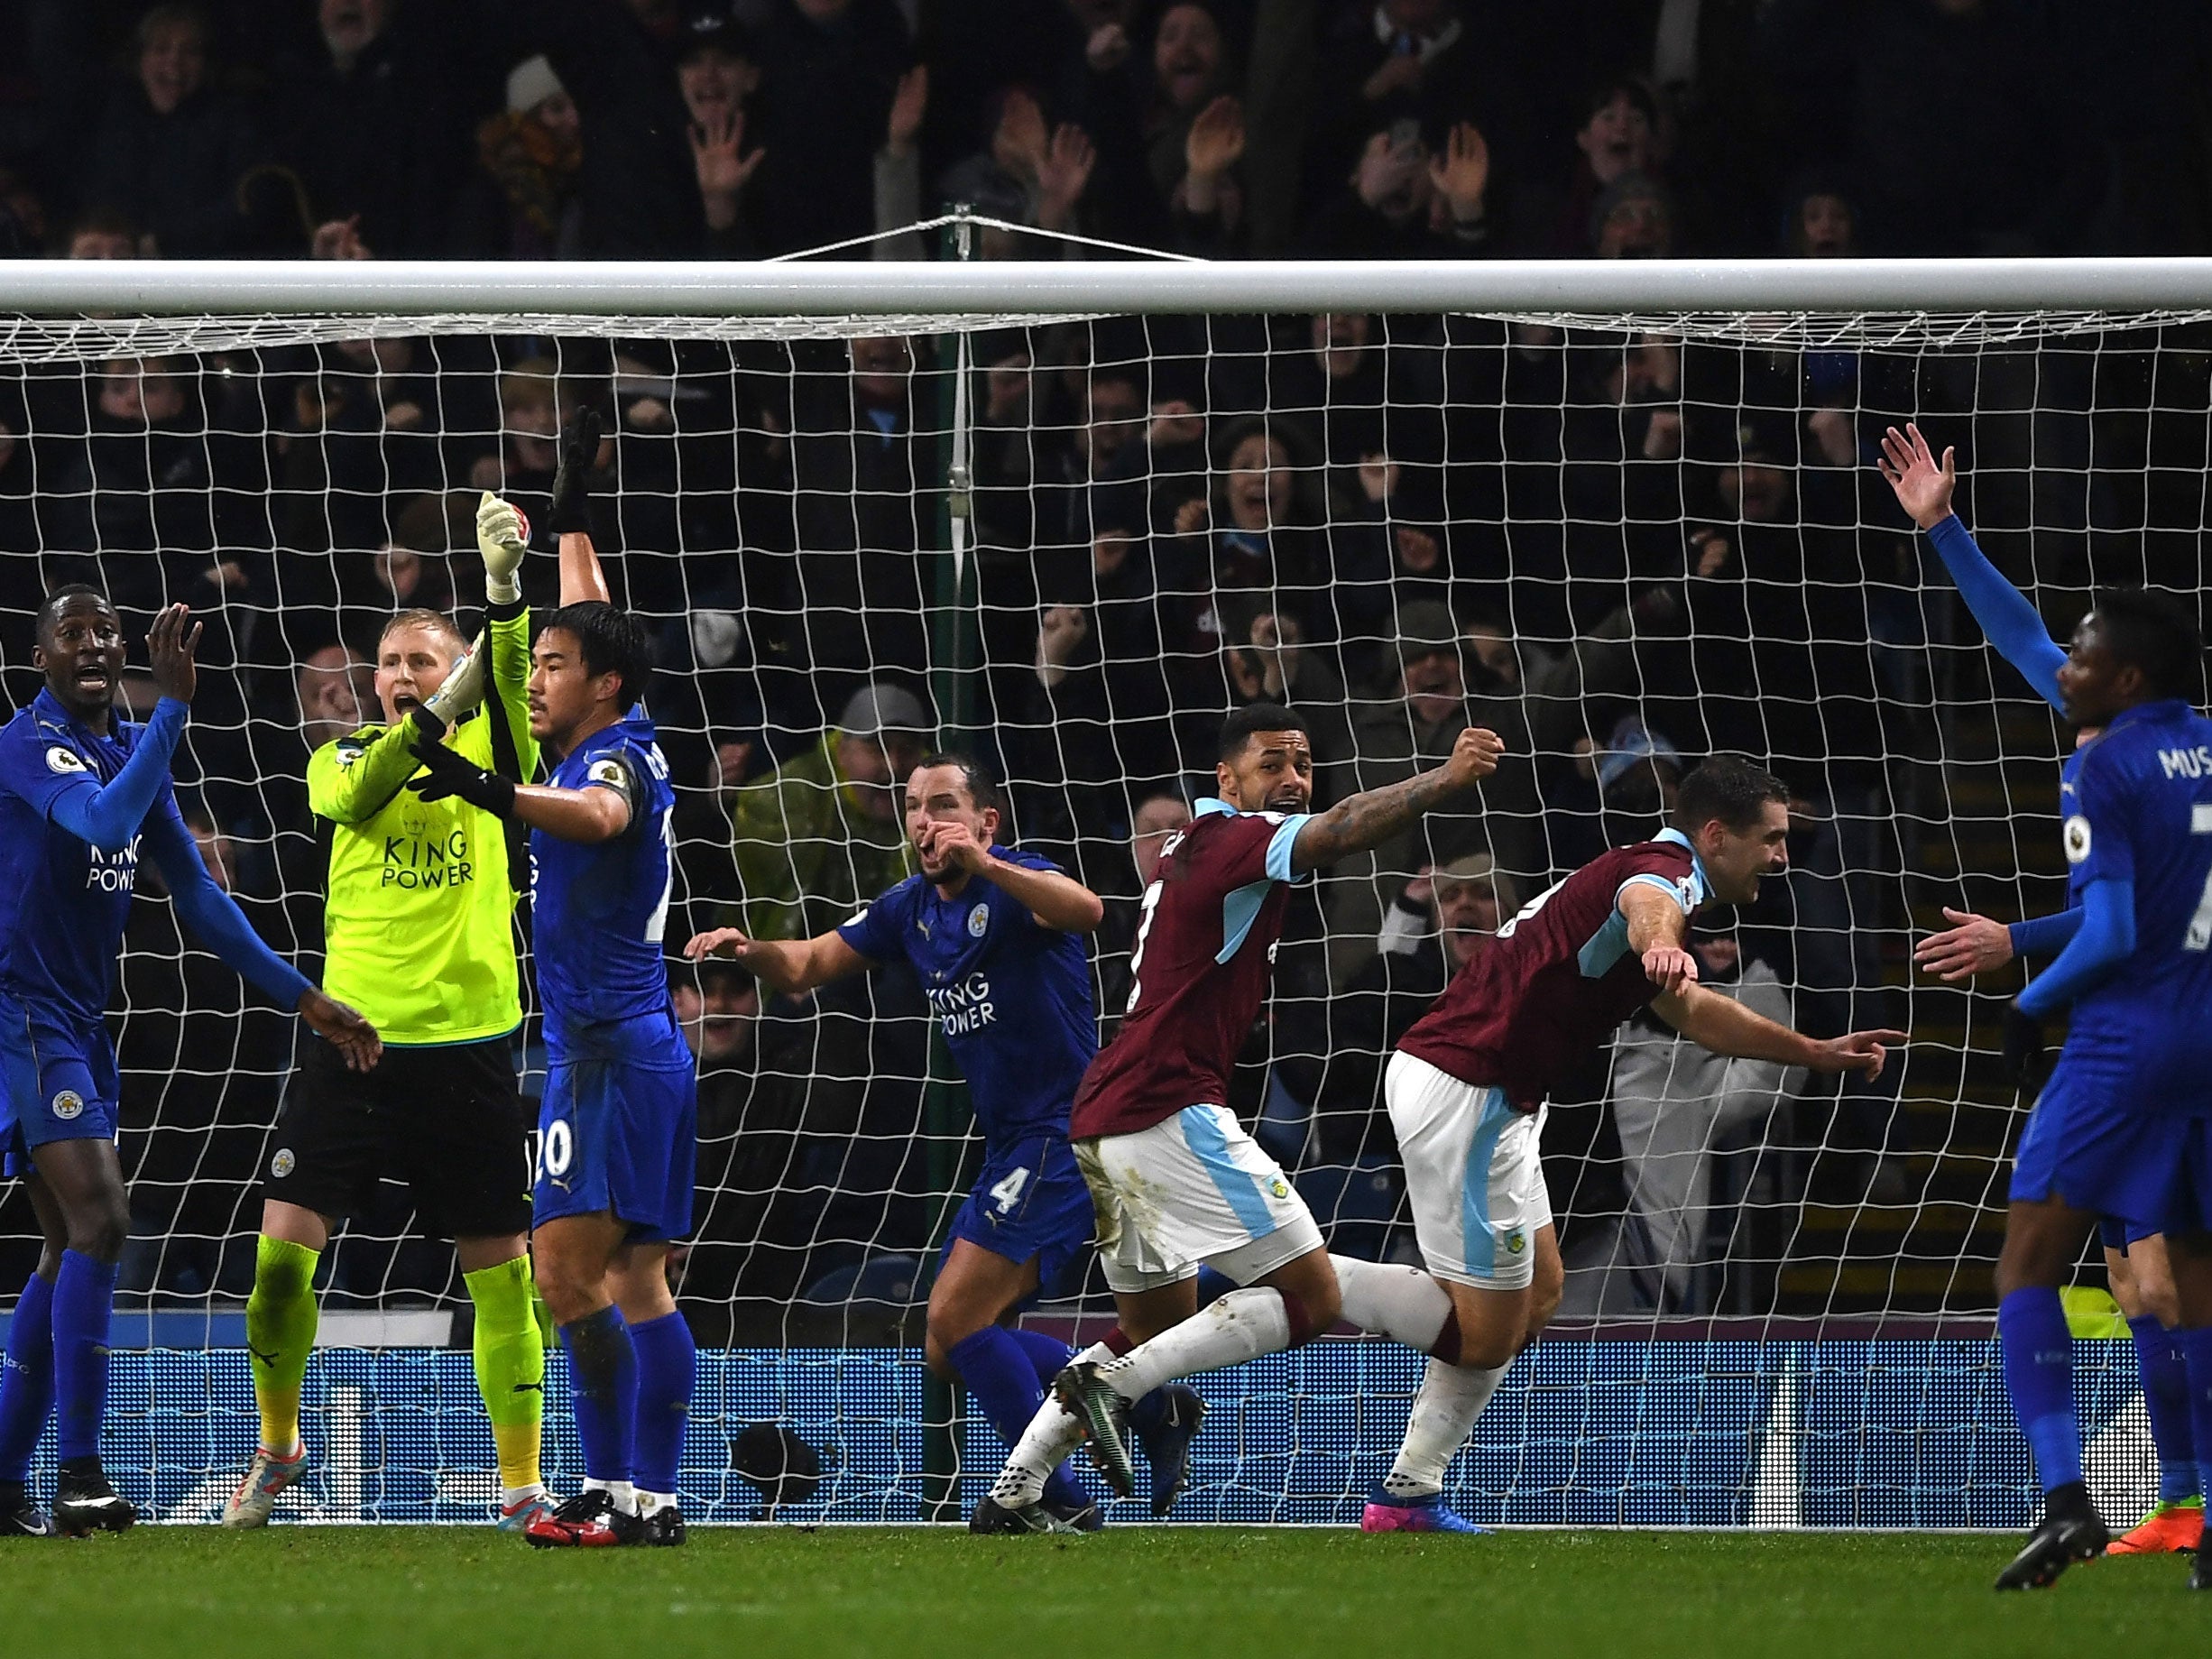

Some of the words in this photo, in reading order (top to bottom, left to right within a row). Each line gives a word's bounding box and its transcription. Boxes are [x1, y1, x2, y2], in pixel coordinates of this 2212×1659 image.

[383, 830, 467, 868] KING
[382, 862, 474, 889] POWER
[926, 972, 990, 1011] KING
[989, 1166, 1031, 1215] 4
